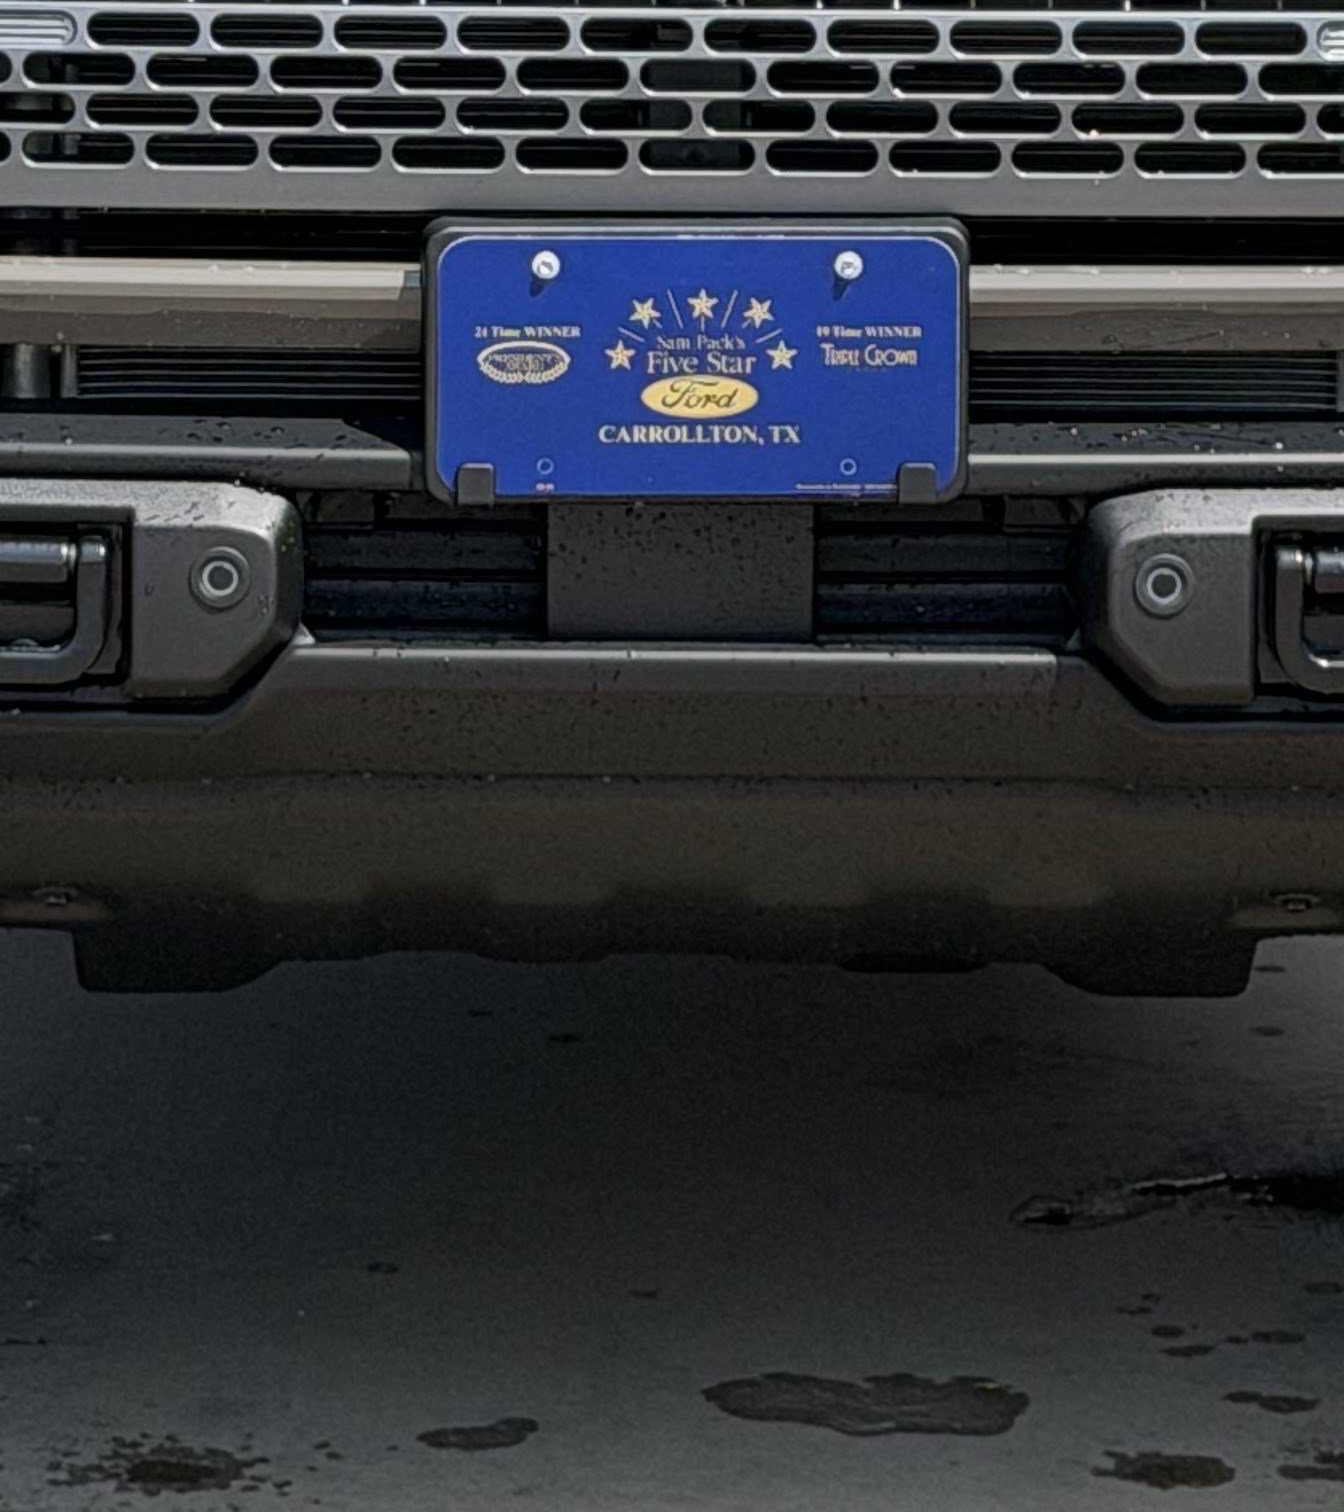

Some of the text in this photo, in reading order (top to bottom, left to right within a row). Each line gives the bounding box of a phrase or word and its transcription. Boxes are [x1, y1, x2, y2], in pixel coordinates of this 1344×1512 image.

[523, 326, 582, 338] WINNER
[864, 326, 923, 338] WINNER
[657, 334, 691, 350] Sam
[647, 350, 758, 375] Five Star
[660, 379, 739, 409] Ford
[598, 425, 801, 446] CARROLLTON, TX
